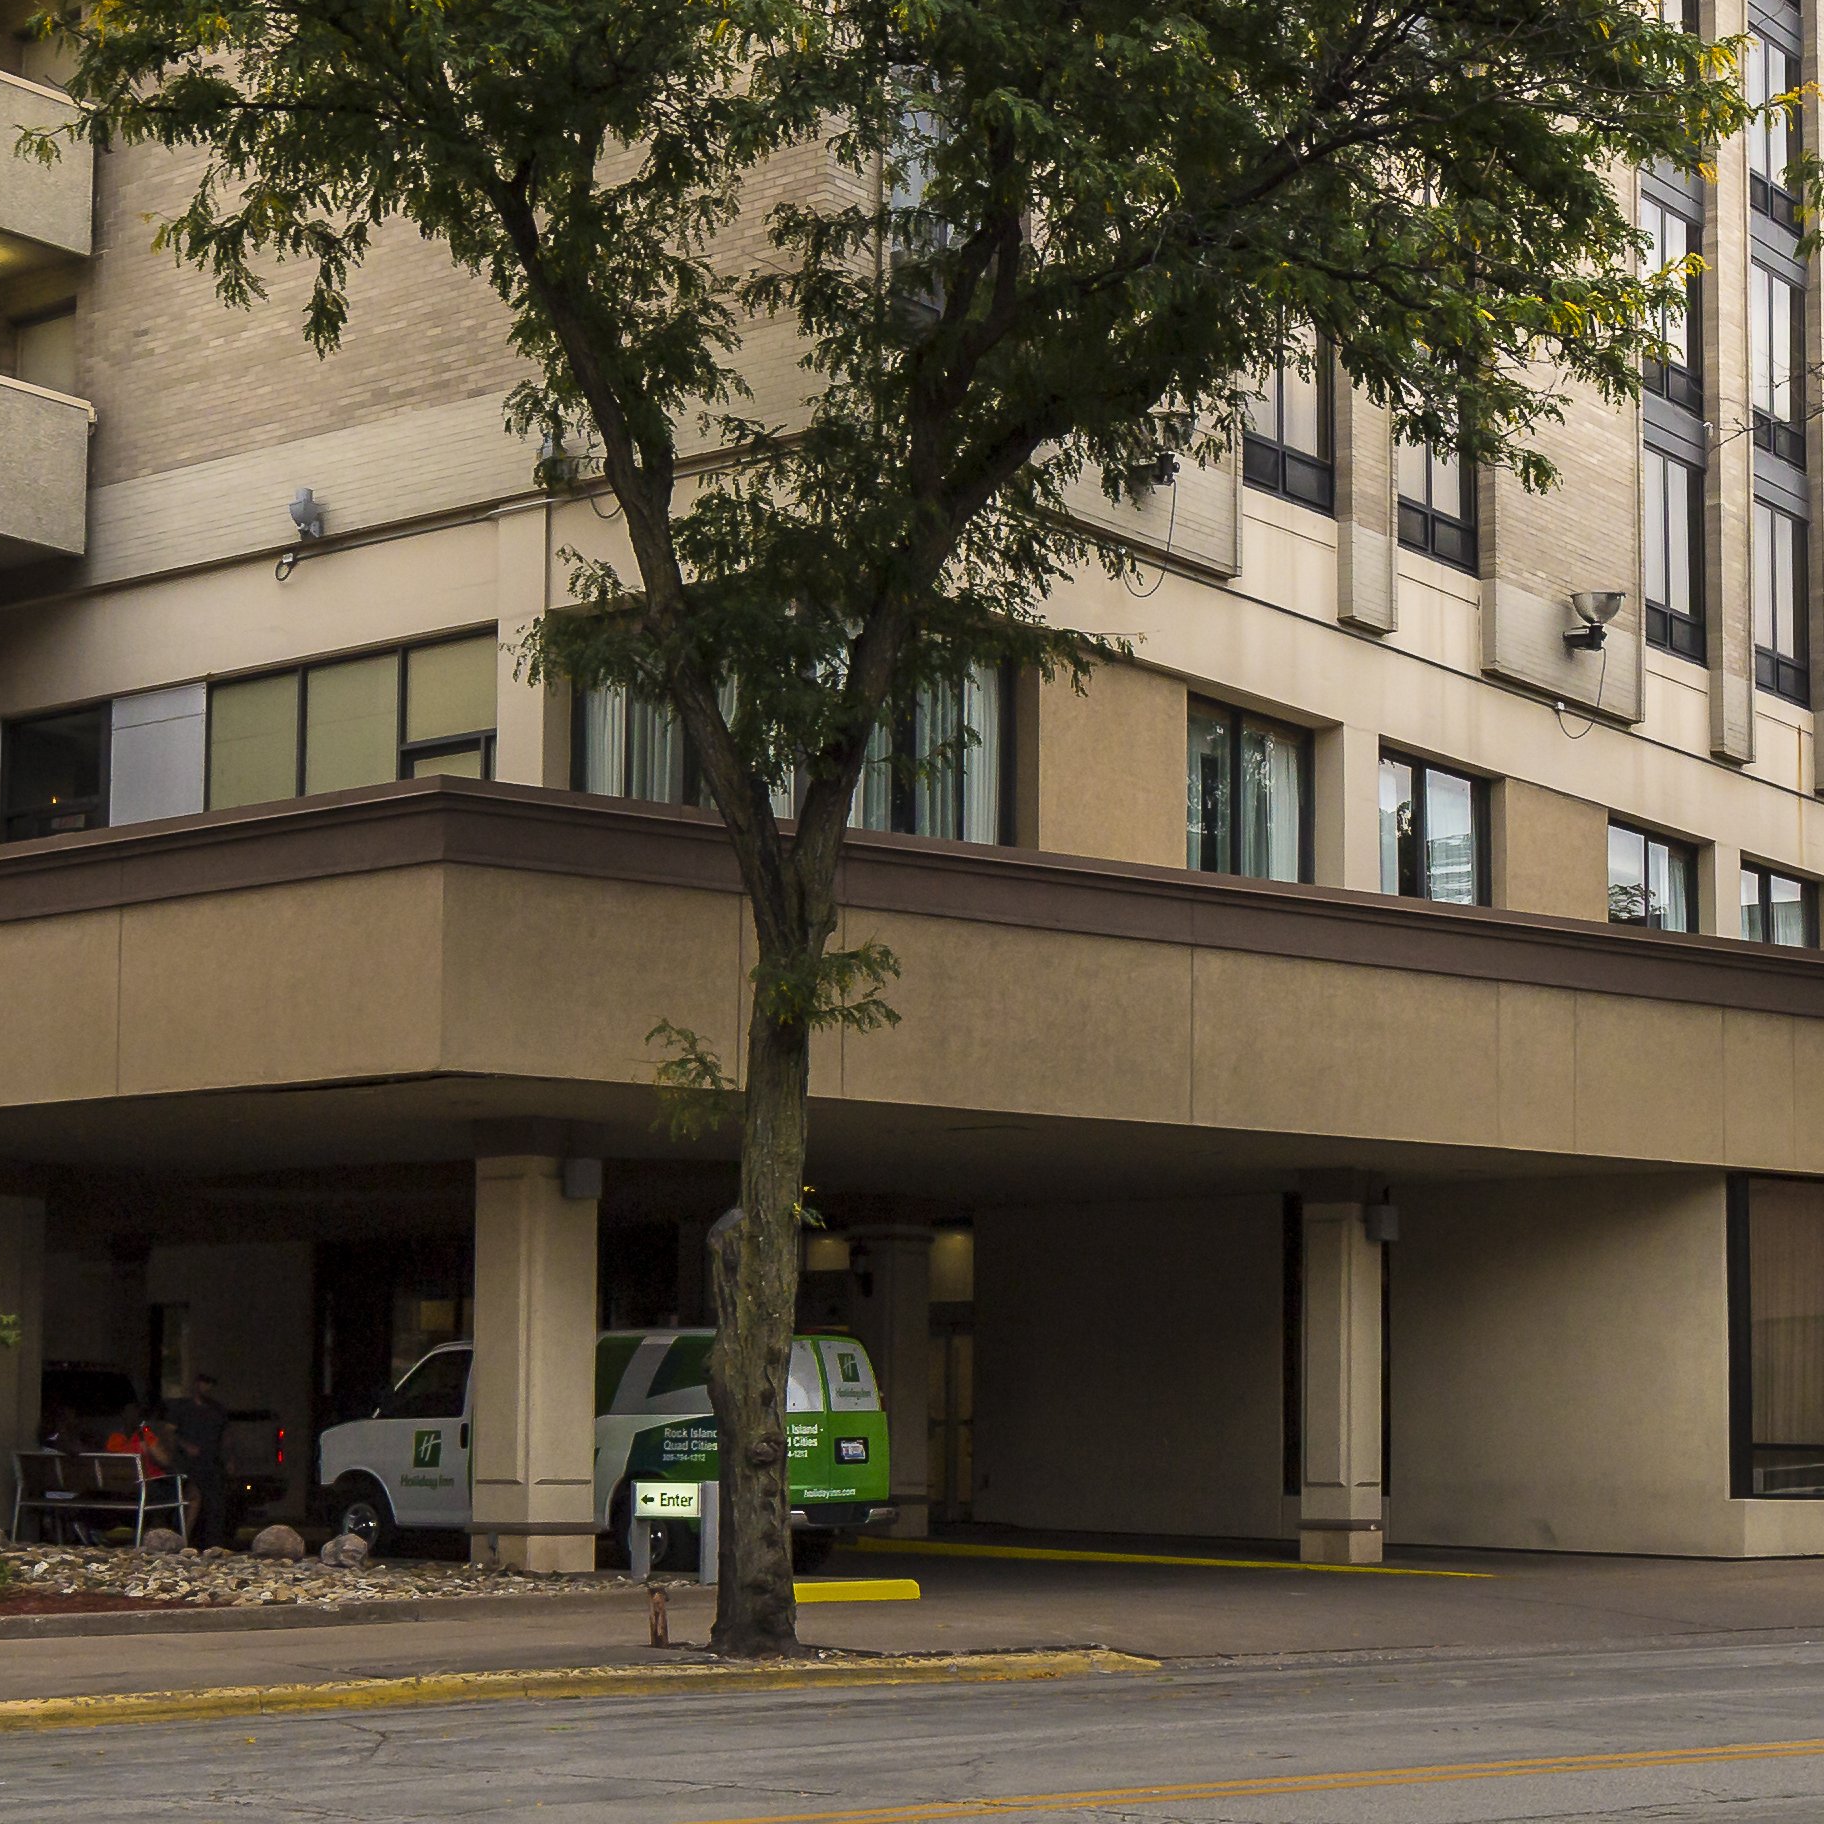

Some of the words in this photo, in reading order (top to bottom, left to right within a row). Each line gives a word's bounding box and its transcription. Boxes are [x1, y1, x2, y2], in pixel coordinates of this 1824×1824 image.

[664, 1428, 688, 1438] Rock
[791, 1424, 818, 1435] Island
[663, 1440, 689, 1450] Quad
[690, 1440, 718, 1451] Cities
[793, 1436, 818, 1447] Cities
[660, 1492, 694, 1507] Enter
